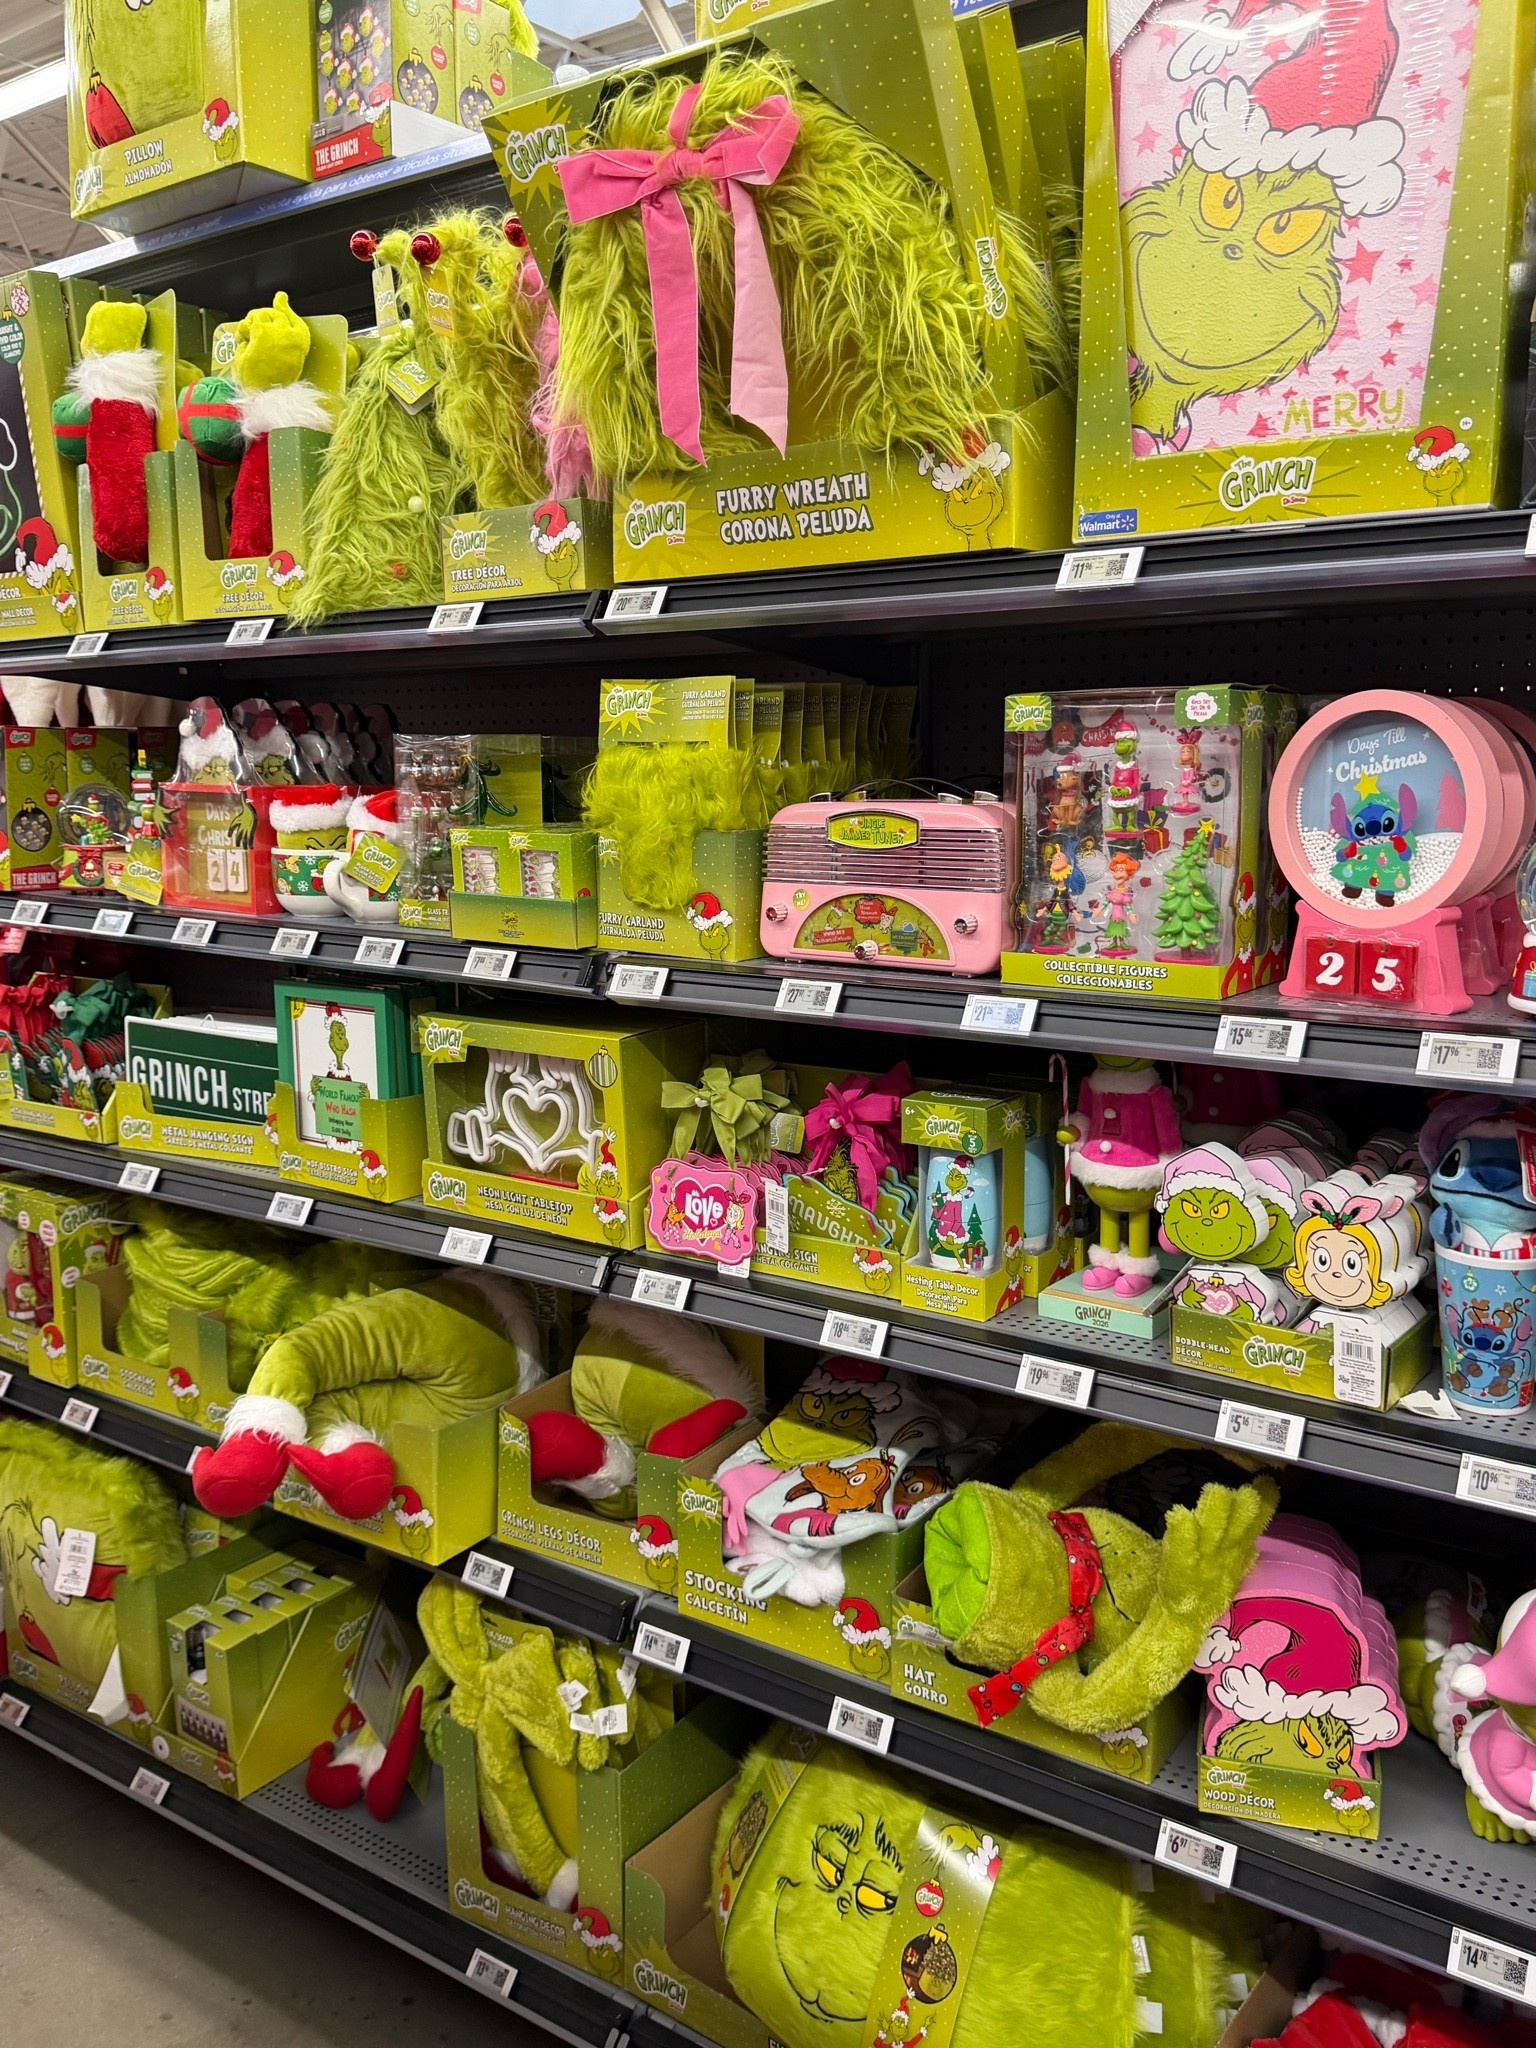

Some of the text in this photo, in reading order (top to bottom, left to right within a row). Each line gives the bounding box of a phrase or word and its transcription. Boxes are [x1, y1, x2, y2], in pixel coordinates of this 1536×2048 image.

[124, 139, 163, 166] PILLOW
[315, 147, 330, 167] THE
[330, 138, 359, 164] GRINCH
[507, 126, 567, 179] GRINCH
[322, 181, 350, 198] para
[349, 168, 393, 190] obtener
[976, 240, 1006, 317] GRINCH
[1281, 388, 1404, 434] MERRY
[1235, 458, 1251, 471] The
[1221, 458, 1313, 507] GRINCH
[716, 472, 868, 515] FURRY WREATH
[631, 501, 643, 512] The
[625, 501, 685, 547] GRINCH
[720, 505, 872, 543] CORONA PELUDA
[1080, 519, 1120, 532] Walmart
[450, 531, 486, 559] GRINCH
[222, 566, 257, 588] GRINCH
[451, 562, 505, 581] TREE DÉCOR
[0, 585, 20, 599] ÉCOR
[487, 580, 504, 590] PARA
[222, 593, 239, 603] TREE
[605, 690, 652, 717] GRINCH
[682, 689, 727, 699] FURRY GARLAND
[706, 699, 725, 708] PELUDA
[755, 696, 781, 705] ARLAND
[1013, 705, 1044, 723] GRINCH
[1347, 727, 1407, 755] Days Till
[1335, 750, 1428, 783] Christmas
[206, 804, 231, 820] DAYS
[859, 816, 886, 830] JINGLE
[839, 829, 904, 845] JAMMER TUNER
[363, 848, 395, 869] GRINCH
[12, 871, 57, 885] THE GRINCH
[128, 863, 160, 881] GRINCH
[211, 860, 240, 885] 2 4
[401, 905, 422, 921] GRINCH
[624, 914, 665, 930] GARLAND
[638, 930, 665, 942] PELUDA
[1043, 959, 1168, 979] COLLECTIBLE FIGURES
[1315, 952, 1400, 991] 2 5
[1056, 974, 1153, 990] COLECCIONABLES
[426, 1029, 462, 1052] GRINCH
[131, 1056, 229, 1109] GRINCH
[325, 1103, 340, 1114] WHO
[905, 1107, 915, 1115] 6+
[121, 1119, 152, 1138] GRINCH
[162, 1126, 254, 1145] METAL HANGING SIGN
[926, 1119, 961, 1137] GRINCH
[969, 1138, 976, 1147] 5
[429, 1178, 466, 1200] GRINCH
[477, 1185, 573, 1215] NEON LIGHT TABLETOP
[61, 1201, 107, 1234] GRINCH
[485, 1200, 546, 1220] MESA CON LUZ DE
[682, 1227, 723, 1240] Holidays
[756, 1256, 819, 1274] METAL COLGANTE
[793, 1250, 818, 1263] SIGN
[905, 1274, 979, 1296] Nesting Table Decor
[916, 1288, 968, 1305] Decoración Para
[925, 1299, 958, 1312] Mesa Nido
[1074, 1305, 1112, 1321] GRINCH
[1092, 1319, 1110, 1328] 2026
[1175, 1336, 1231, 1355] BOBBLE-HEAD
[1253, 1337, 1265, 1345] The
[1175, 1345, 1202, 1360] DÉCOR
[1245, 1343, 1305, 1369] GRINCH
[502, 1424, 527, 1446] GRINCH
[682, 1491, 718, 1514] GRINCH
[501, 1509, 602, 1553] GRINCH LEGS DÉCOR
[904, 1663, 936, 1686] HAT
[904, 1682, 948, 1705] GORRO
[1208, 1770, 1246, 1785] GRINCH
[1203, 1789, 1275, 1809] WOOD DÉCOR
[1203, 1802, 1281, 1820] DECORACIÓN DE MADERA
[455, 1883, 499, 1916] GRINCH
[917, 1889, 942, 1906] GRINCH
[505, 1904, 539, 1927] HANGING
[634, 1964, 687, 2006] GRINCH
